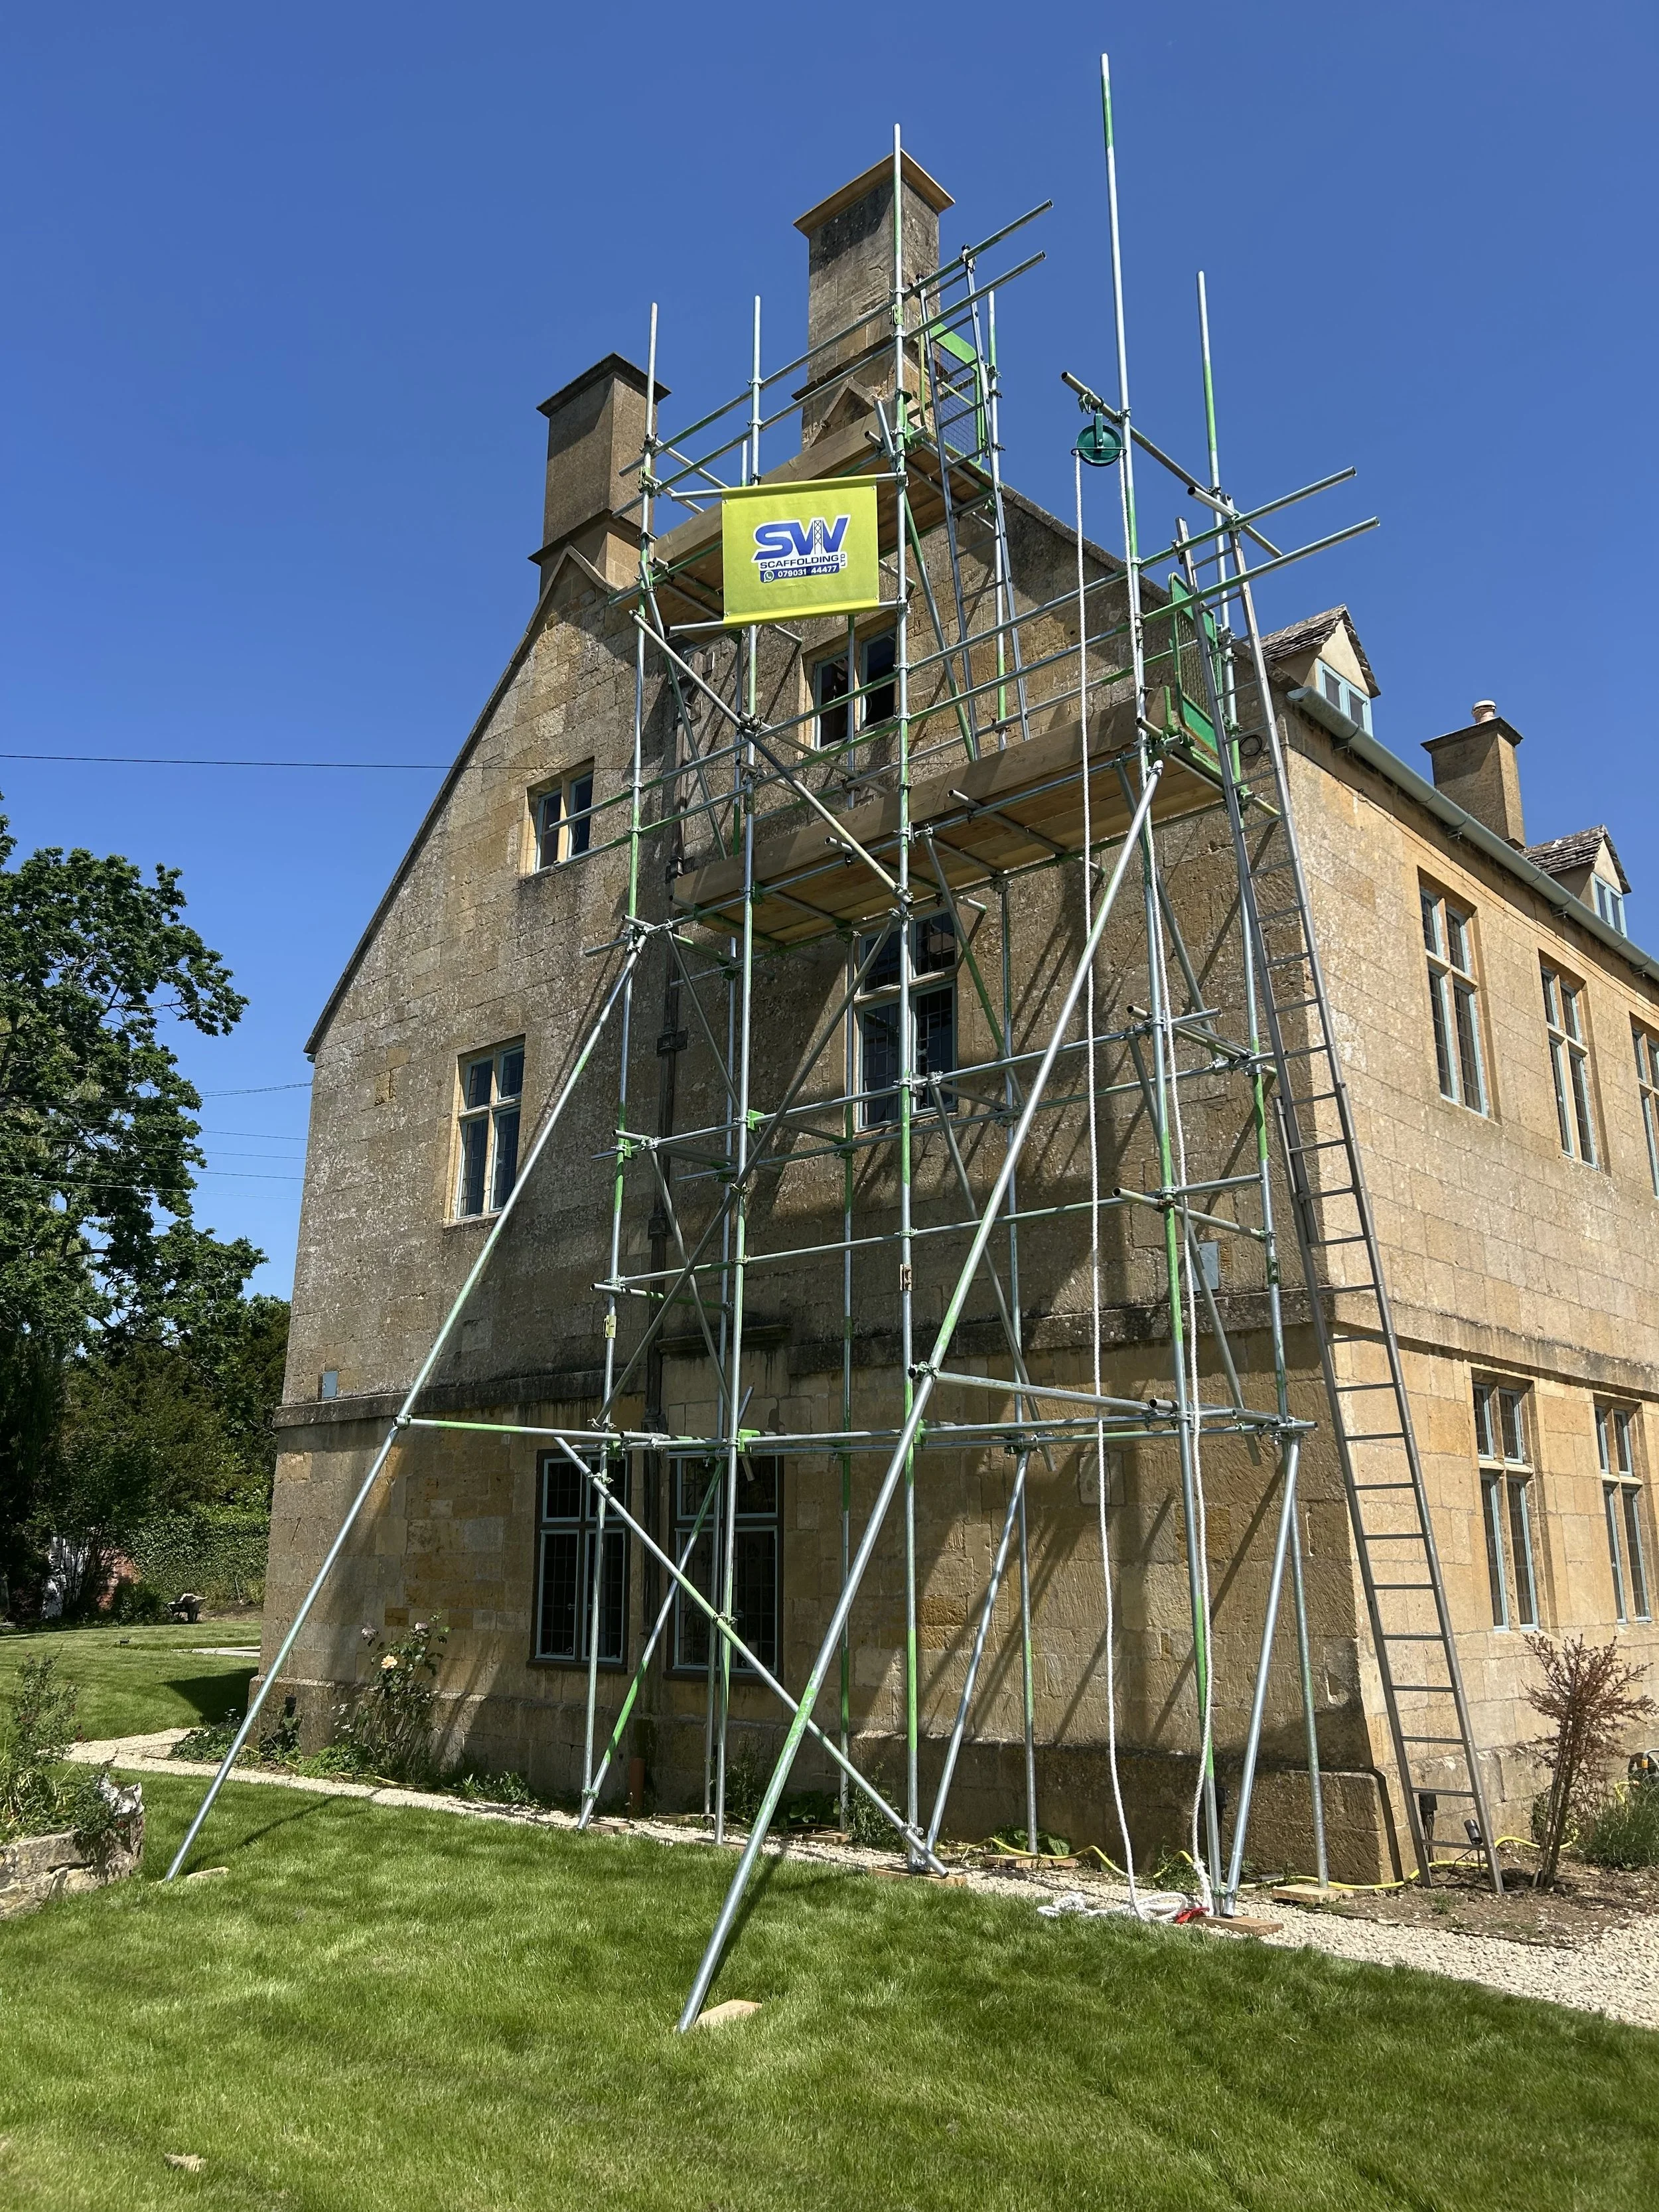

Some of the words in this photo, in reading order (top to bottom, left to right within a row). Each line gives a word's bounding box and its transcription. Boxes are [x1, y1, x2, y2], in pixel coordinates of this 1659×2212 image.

[754, 518, 848, 560] SW
[760, 555, 839, 569] SCAFFOLDING
[777, 568, 807, 577] 079031
[811, 565, 837, 574] 44477
